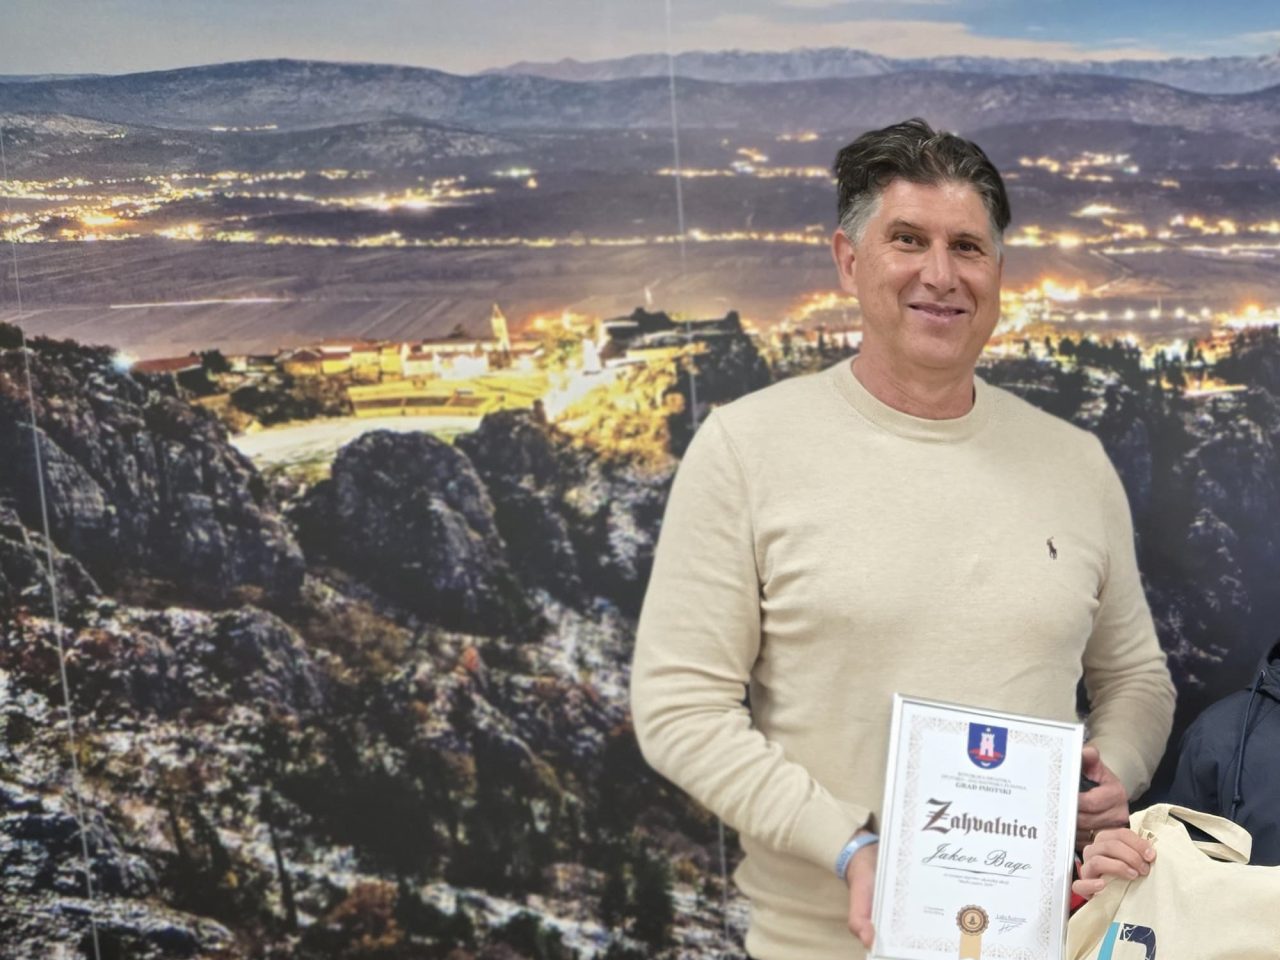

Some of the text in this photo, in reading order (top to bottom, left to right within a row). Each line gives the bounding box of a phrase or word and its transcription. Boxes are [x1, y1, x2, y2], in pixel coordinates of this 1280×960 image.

[920, 797, 1039, 840] Zahvalnica
[921, 842, 1033, 875] Jakov Bago
